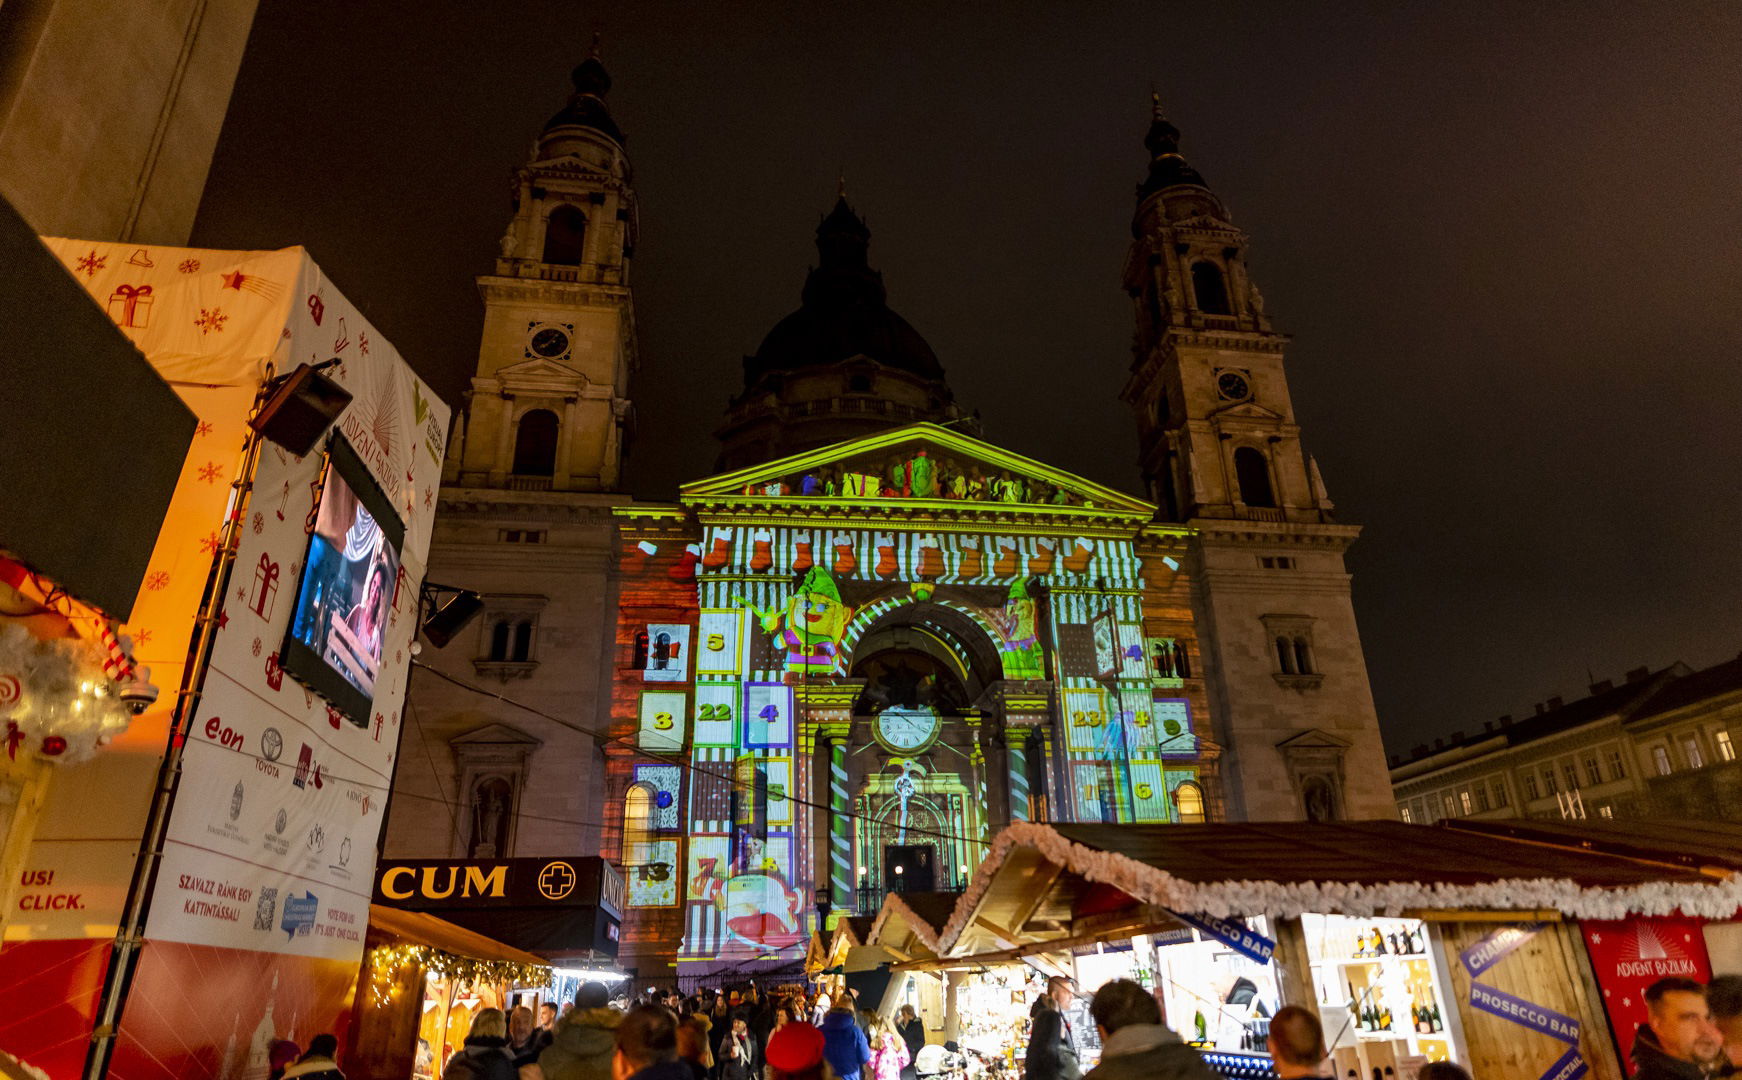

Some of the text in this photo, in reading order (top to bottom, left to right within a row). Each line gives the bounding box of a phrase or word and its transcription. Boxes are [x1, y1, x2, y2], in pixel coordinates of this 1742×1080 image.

[342, 412, 377, 462] ADVENT
[707, 633, 725, 652] 5
[653, 711, 674, 730] 3
[698, 703, 732, 721] 22
[759, 704, 779, 723] 4
[255, 758, 280, 779] TOYOTA
[20, 870, 55, 887] US!
[179, 874, 252, 902] SZAVAZZ RÁNK EGY
[380, 866, 509, 900] CUM
[19, 894, 85, 911] CLICK.
[327, 908, 338, 920] VOTE
[1242, 935, 1272, 960] BAR
[1616, 960, 1698, 977] ADVENT BAZILIKA
[1472, 988, 1579, 1039] PROSECCO BAR
